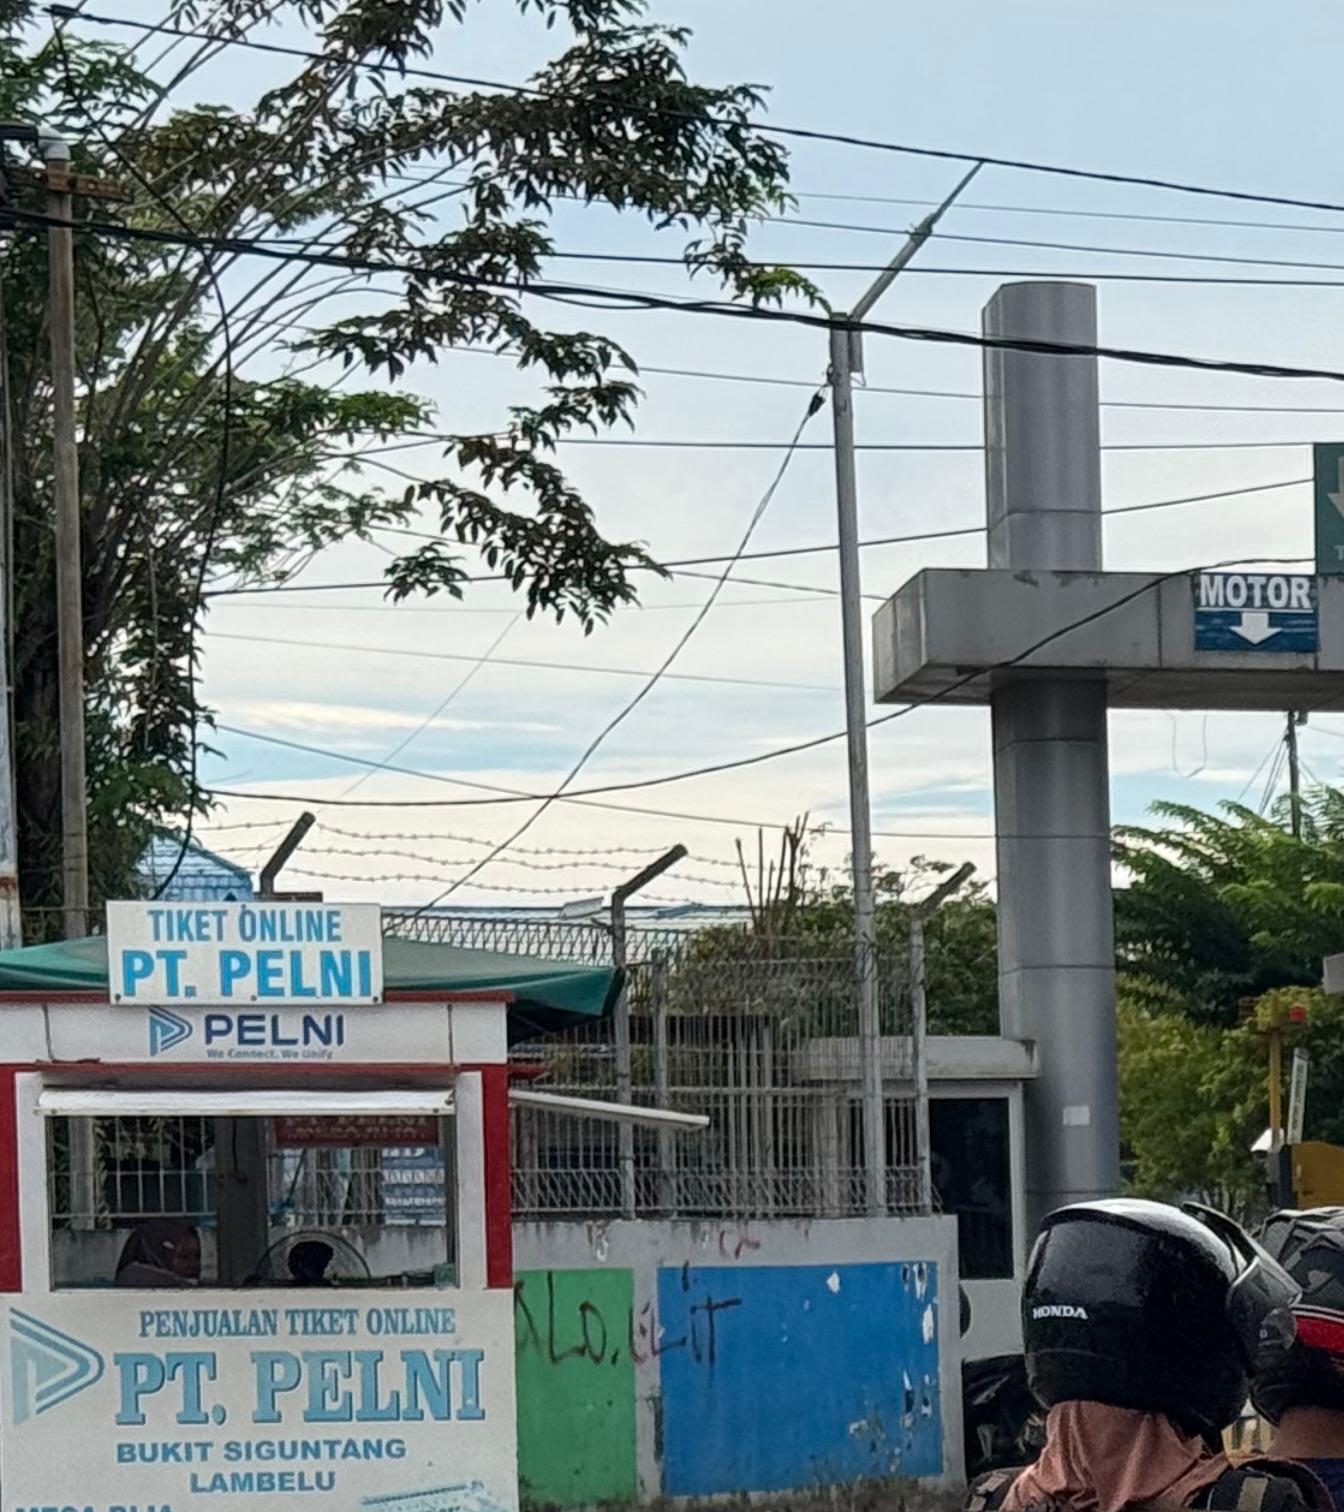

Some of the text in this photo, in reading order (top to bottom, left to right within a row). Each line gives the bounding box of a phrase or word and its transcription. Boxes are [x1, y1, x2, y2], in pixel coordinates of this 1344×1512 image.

[1199, 574, 1312, 609] MOTOR
[148, 909, 341, 943] TIKET ONLINE
[122, 950, 372, 997] PT. PELNI
[205, 1014, 345, 1047] PELNI
[206, 1049, 225, 1059] We
[281, 1048, 299, 1059] We
[139, 1308, 456, 1338] PENJUALAN TIKET ONLINE
[1032, 1304, 1089, 1321] HONDA
[113, 1348, 487, 1426] PT. PELNI
[117, 1438, 407, 1464] BUKIT SIGUNTANG
[190, 1471, 337, 1494] LAMBELU
